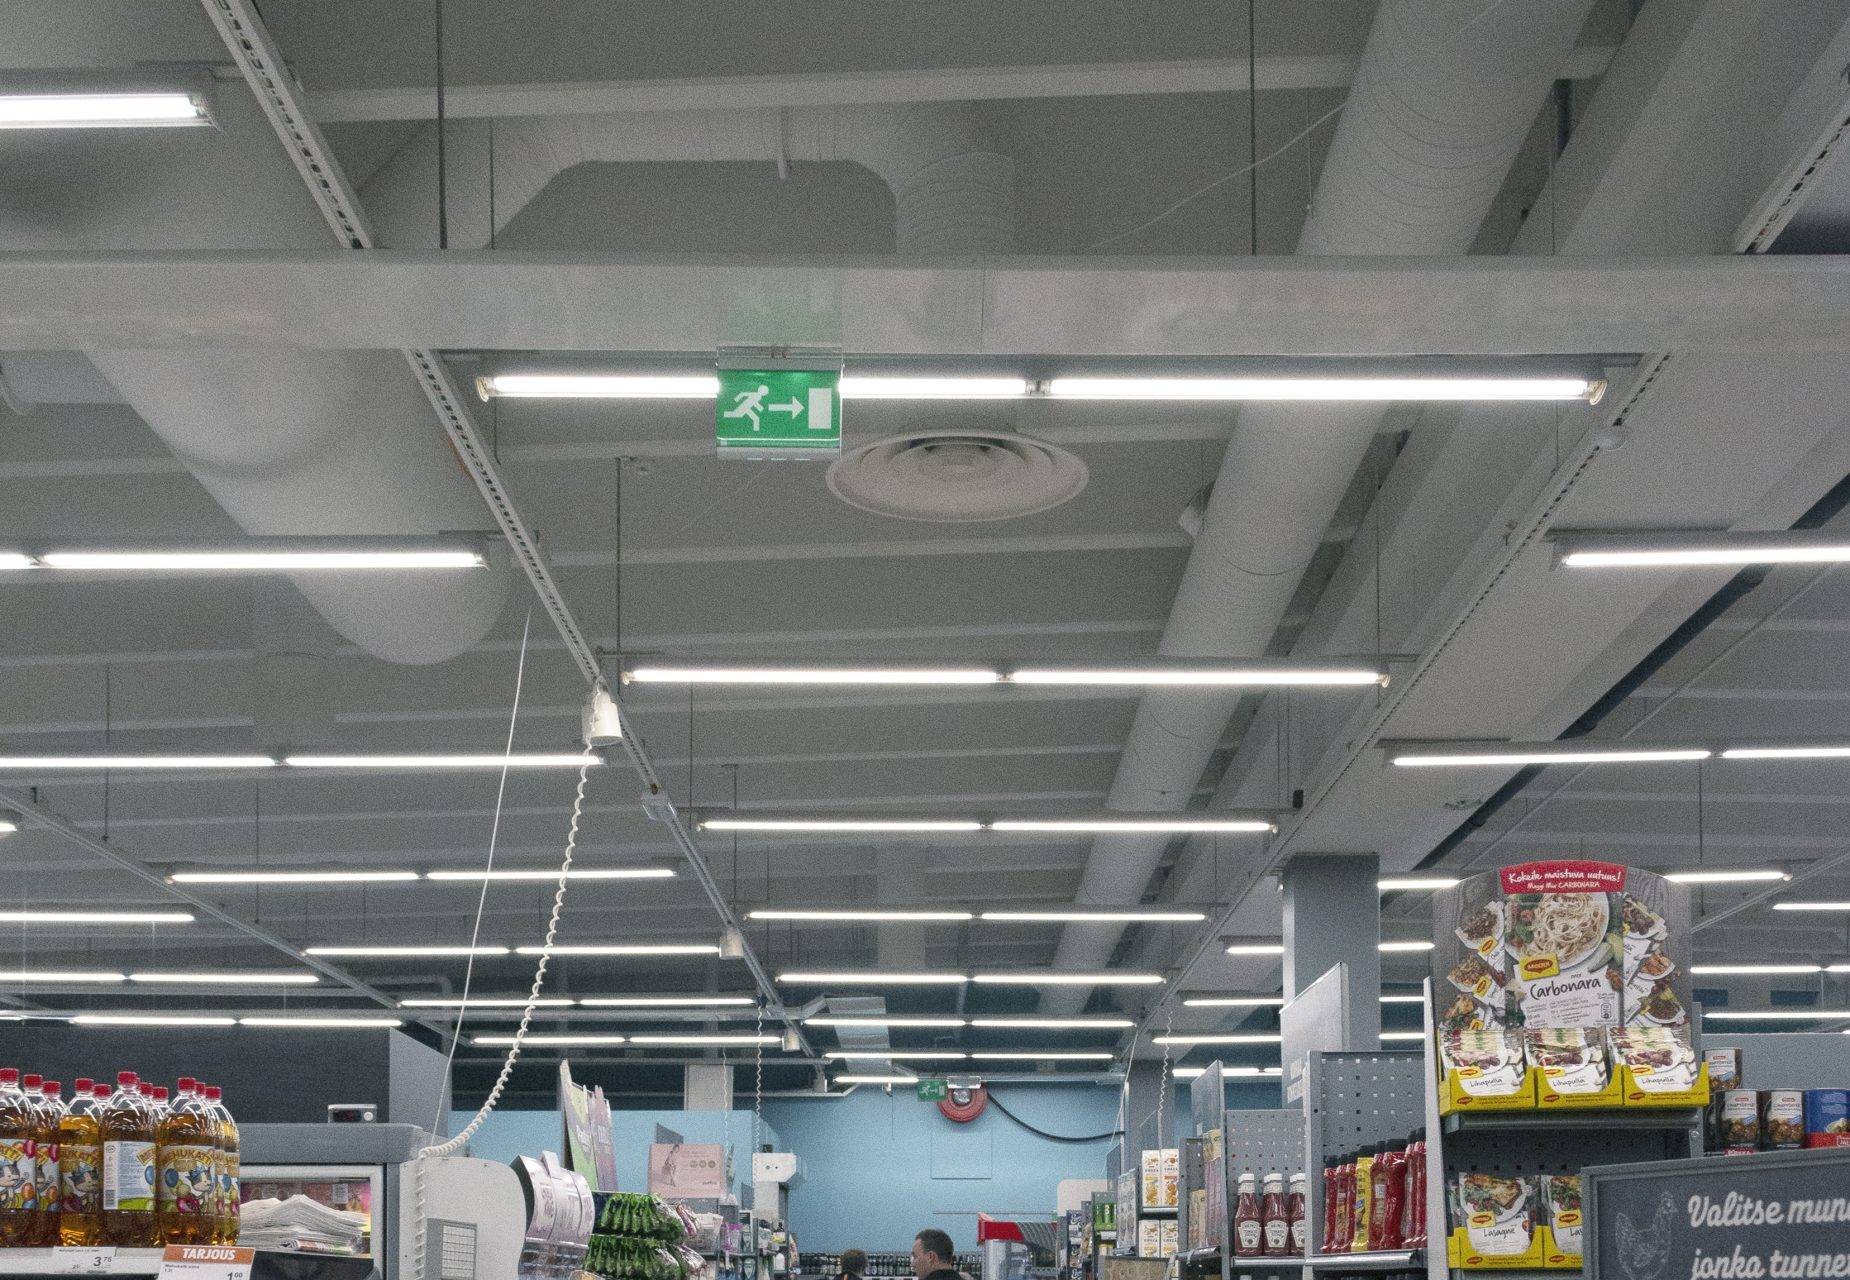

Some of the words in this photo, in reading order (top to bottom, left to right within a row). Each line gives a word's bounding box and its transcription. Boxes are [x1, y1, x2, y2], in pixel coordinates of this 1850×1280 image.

[1508, 870, 1542, 883] Kokeile
[1530, 978, 1602, 1001] Carbonara
[1688, 1191, 1785, 1227] Valitse
[1483, 1226, 1515, 1239] Lasagne
[182, 1248, 235, 1260] TARJOUS
